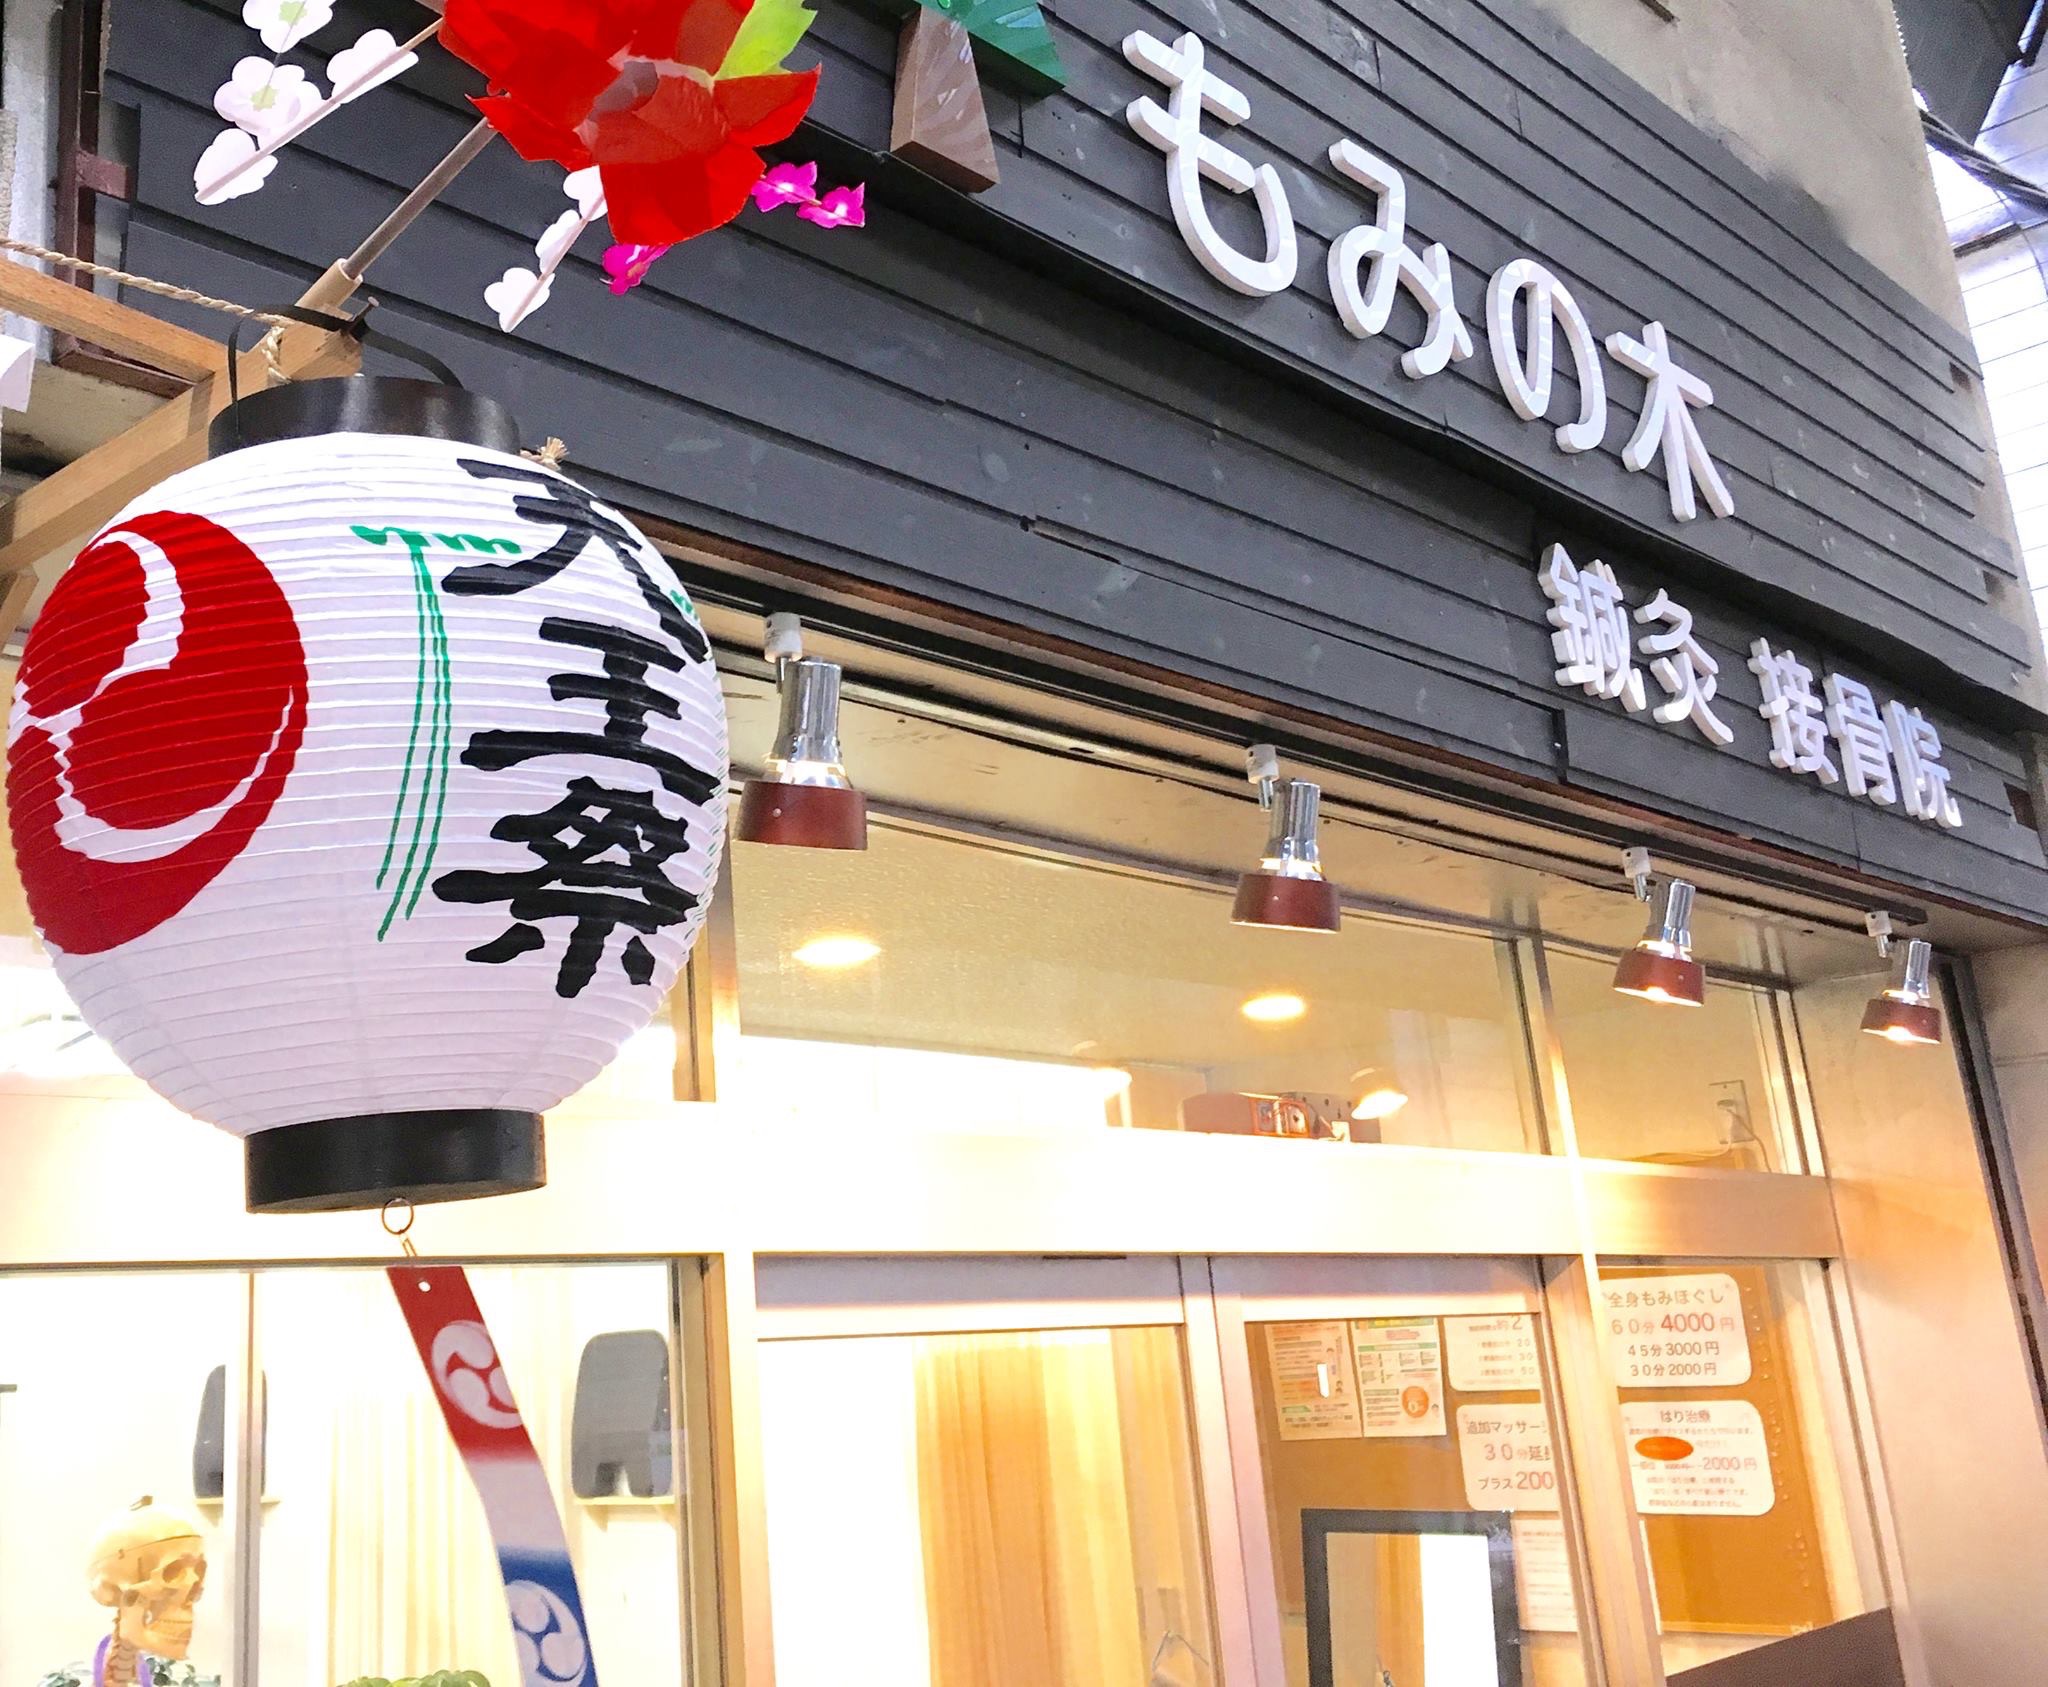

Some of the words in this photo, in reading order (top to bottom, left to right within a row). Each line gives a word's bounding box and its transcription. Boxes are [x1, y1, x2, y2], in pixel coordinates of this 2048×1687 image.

[1122, 30, 1734, 521] もみの木
[432, 458, 721, 998] 天王祭
[1747, 637, 1963, 828] 接骨院
[1608, 1288, 1724, 1308] 全身もみほぐし
[1660, 1410, 1711, 1423] はり治療
